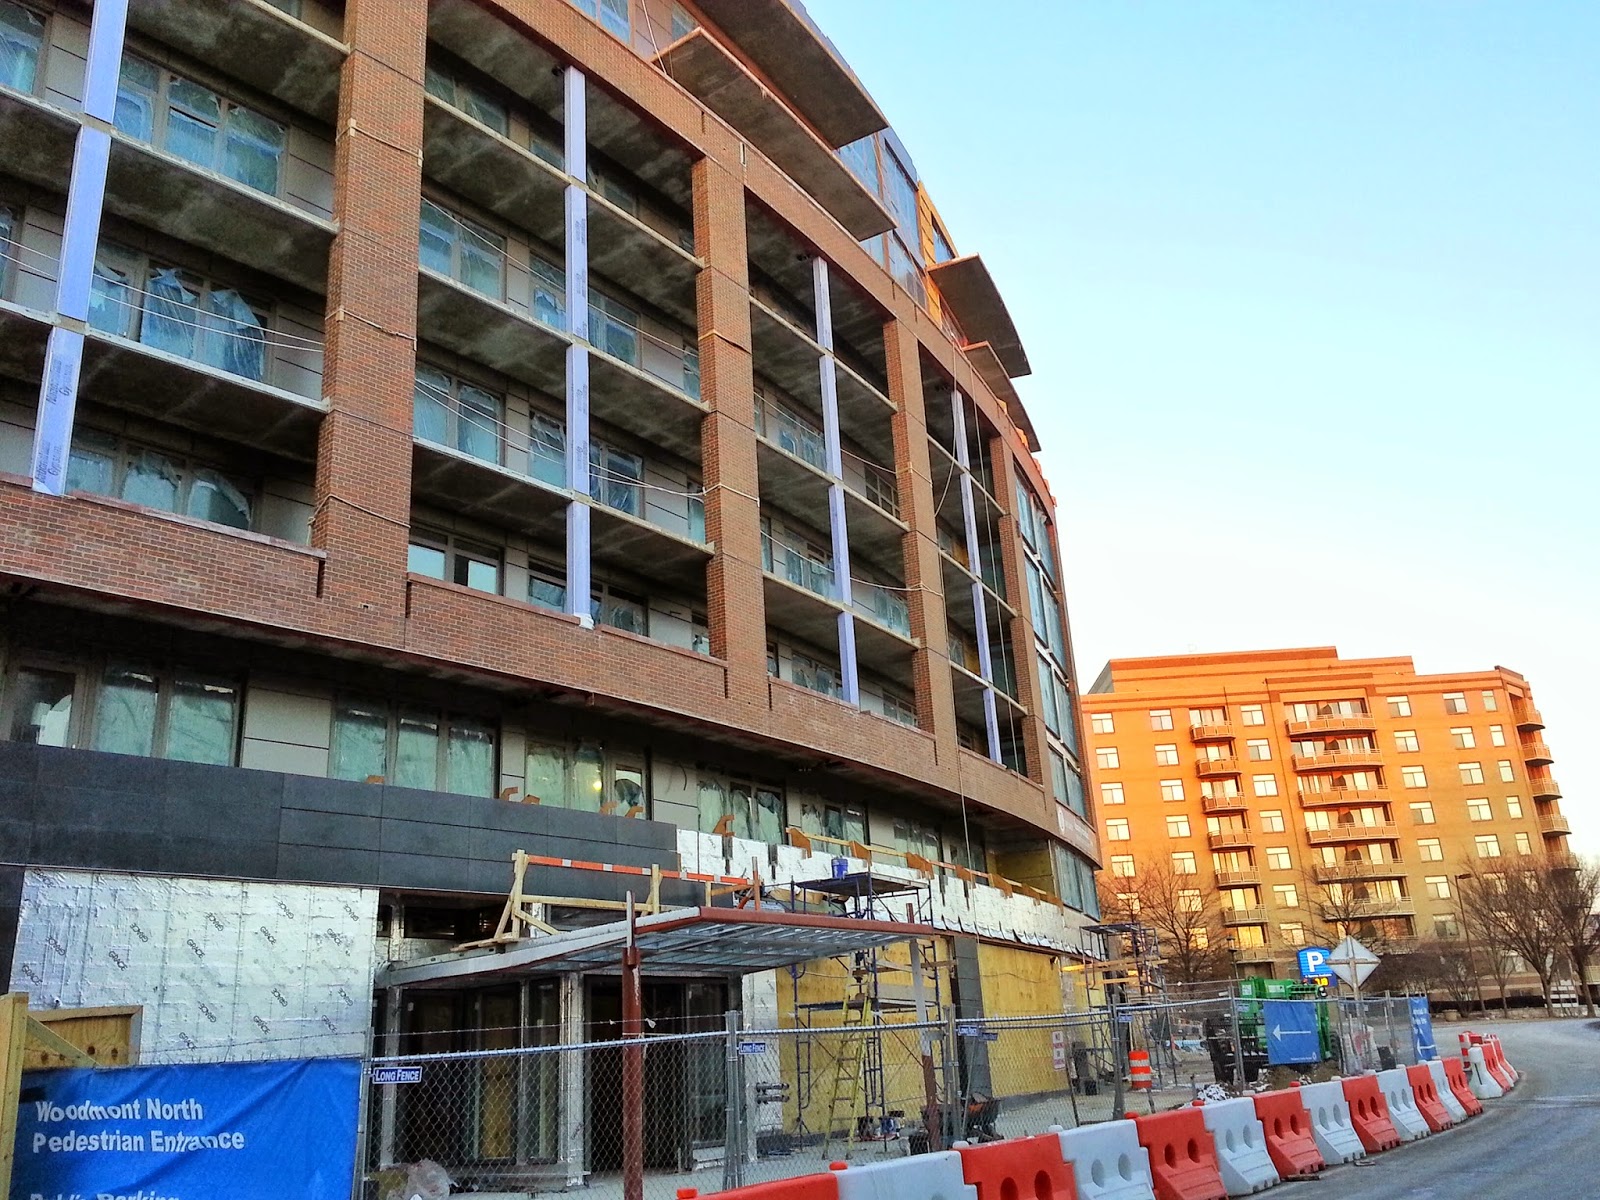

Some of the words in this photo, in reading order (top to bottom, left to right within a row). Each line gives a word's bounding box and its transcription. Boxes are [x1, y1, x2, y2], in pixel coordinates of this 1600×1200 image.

[1307, 952, 1324, 972] P
[376, 1069, 397, 1081] LONG
[397, 1069, 420, 1081] FENCE
[35, 1099, 141, 1122] Woodmont
[146, 1098, 203, 1120] North
[32, 1130, 145, 1153] Pedestrian
[150, 1130, 245, 1152] Entrance
